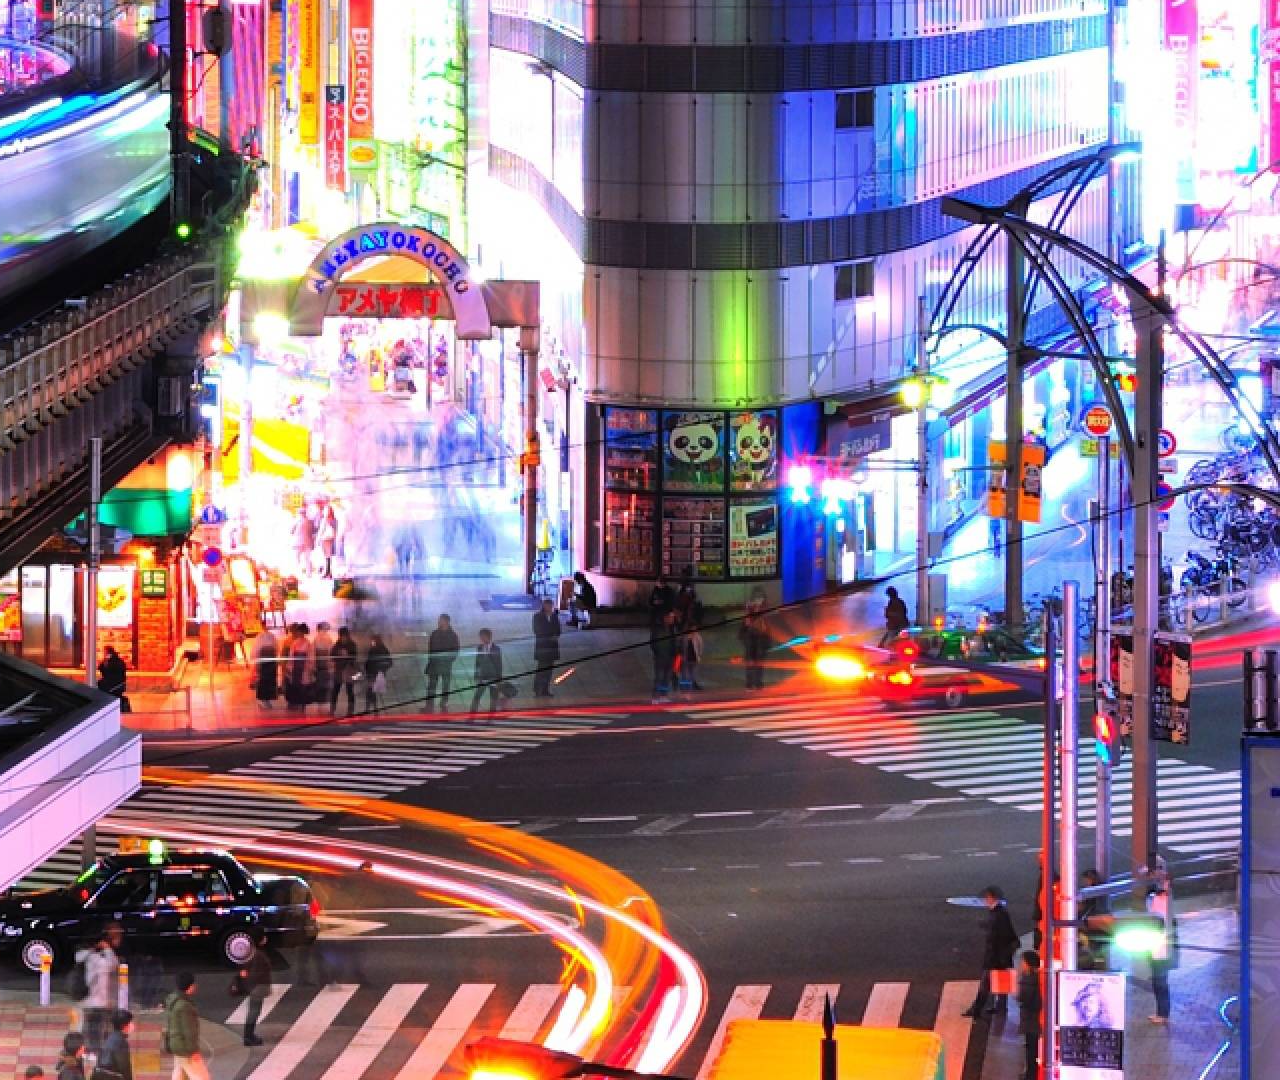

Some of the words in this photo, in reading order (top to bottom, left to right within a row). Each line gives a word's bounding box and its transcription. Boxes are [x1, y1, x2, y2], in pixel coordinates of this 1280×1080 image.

[335, 284, 444, 316] アメヤ横丁
